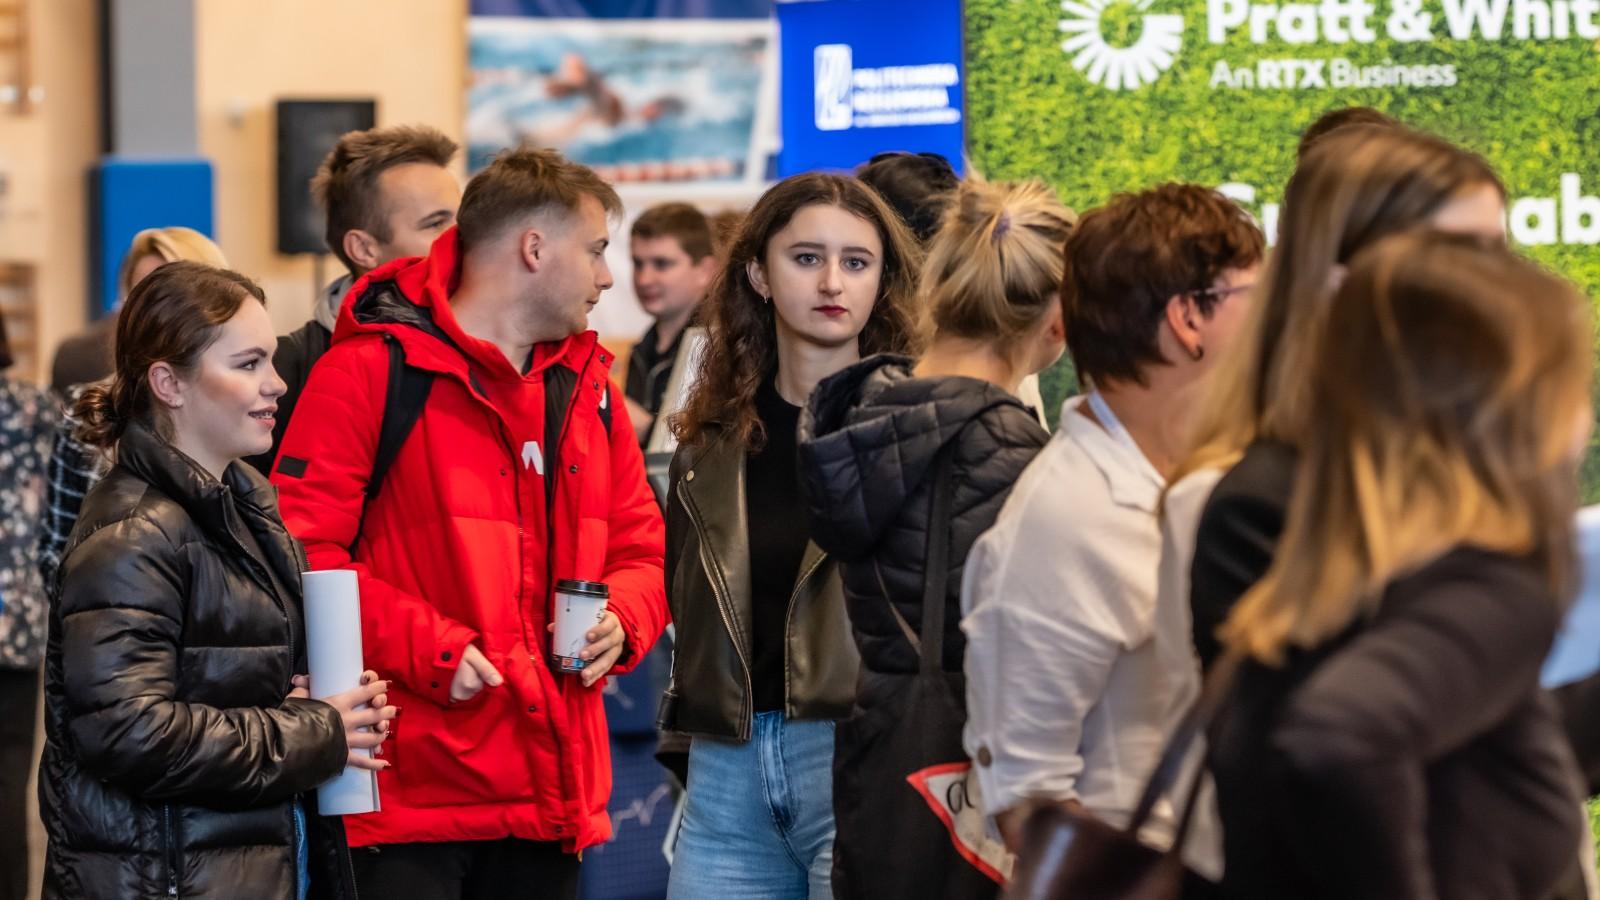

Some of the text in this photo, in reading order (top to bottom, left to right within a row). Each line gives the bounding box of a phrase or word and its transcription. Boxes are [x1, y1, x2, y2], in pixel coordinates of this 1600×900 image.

[1208, 0, 1376, 43] Pratt
[1386, 0, 1434, 41] &
[1210, 58, 1457, 88] An RTX Business
